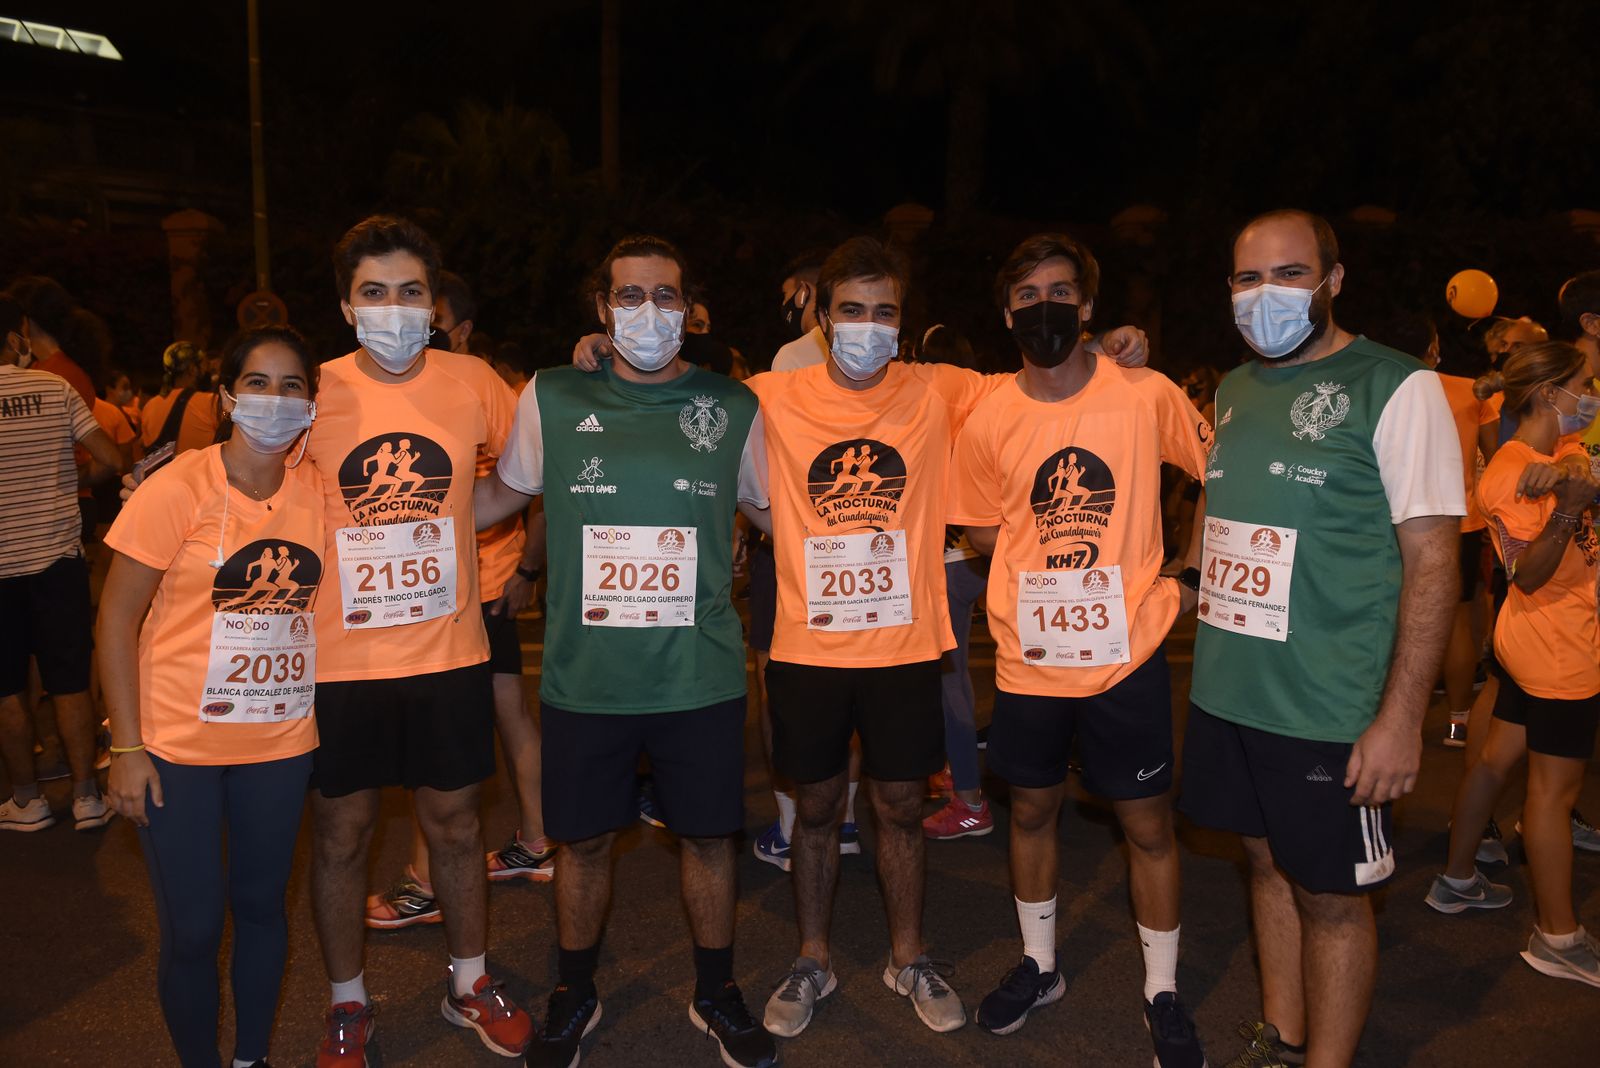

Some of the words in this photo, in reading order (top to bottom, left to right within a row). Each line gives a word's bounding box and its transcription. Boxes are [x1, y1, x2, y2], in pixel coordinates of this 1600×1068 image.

[0, 394, 42, 417] ARTY
[596, 484, 617, 494] GAMES
[1295, 475, 1325, 487] Academy
[353, 511, 365, 523] LA
[368, 501, 440, 516] NOCTURNA
[816, 506, 831, 518] LA
[833, 498, 897, 513] NOCTURNA
[827, 516, 838, 527] del
[838, 511, 889, 524] Guadalquivir
[1046, 513, 1108, 528] NOCTURNA
[1039, 533, 1051, 545] del
[1051, 526, 1101, 539] Guadalquivir
[356, 556, 441, 592] 2156
[599, 562, 680, 591] 2026
[820, 566, 893, 596] 2033
[1207, 556, 1271, 597] 4729
[353, 595, 382, 604] ANDRÉS
[385, 592, 412, 602] TINOCO
[414, 586, 446, 598] DELGADO
[584, 594, 622, 602] ALEJANDRO
[1227, 596, 1247, 606] GARCÍA
[1248, 600, 1286, 612] FERNÁNDEZ
[1033, 603, 1109, 632] 1433
[225, 652, 306, 684] 2039
[206, 688, 241, 696] BLANCA
[243, 688, 282, 696] GONZALEZ
[283, 687, 291, 695] DE
[292, 684, 313, 694] PABLOS
